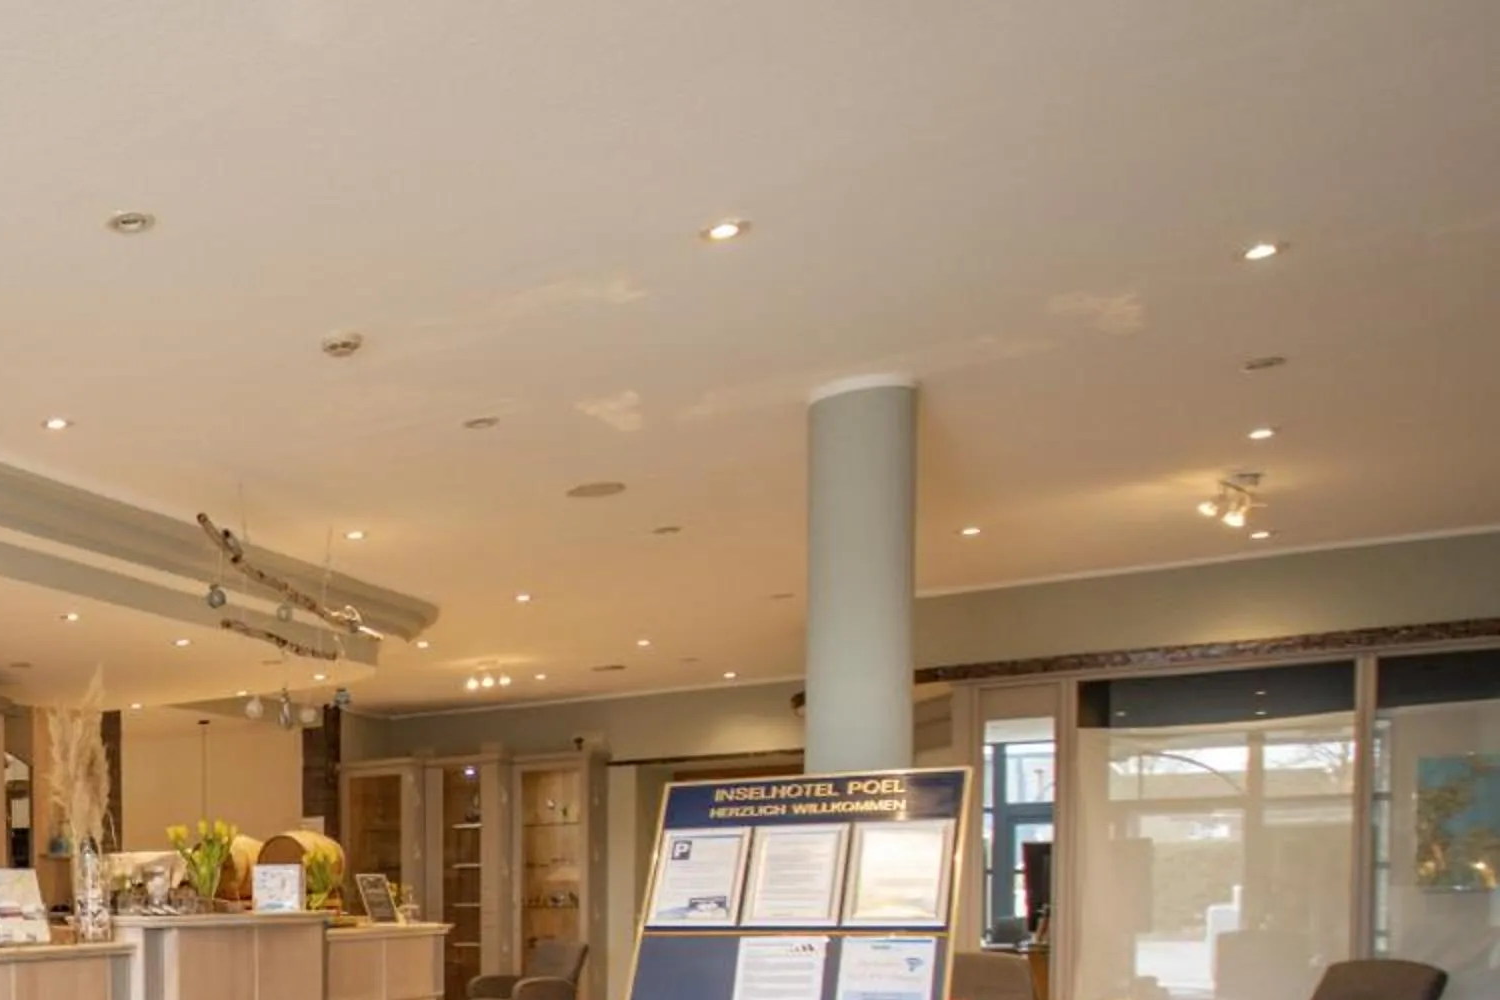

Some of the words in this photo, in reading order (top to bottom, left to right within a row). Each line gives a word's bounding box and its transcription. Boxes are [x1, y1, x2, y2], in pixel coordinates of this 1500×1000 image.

[714, 783, 840, 803] INSELHOTEL
[847, 779, 907, 796] POEL
[709, 804, 786, 819] HERZLICH
[792, 799, 907, 815] WILLKOMMEN
[673, 842, 689, 858] P
